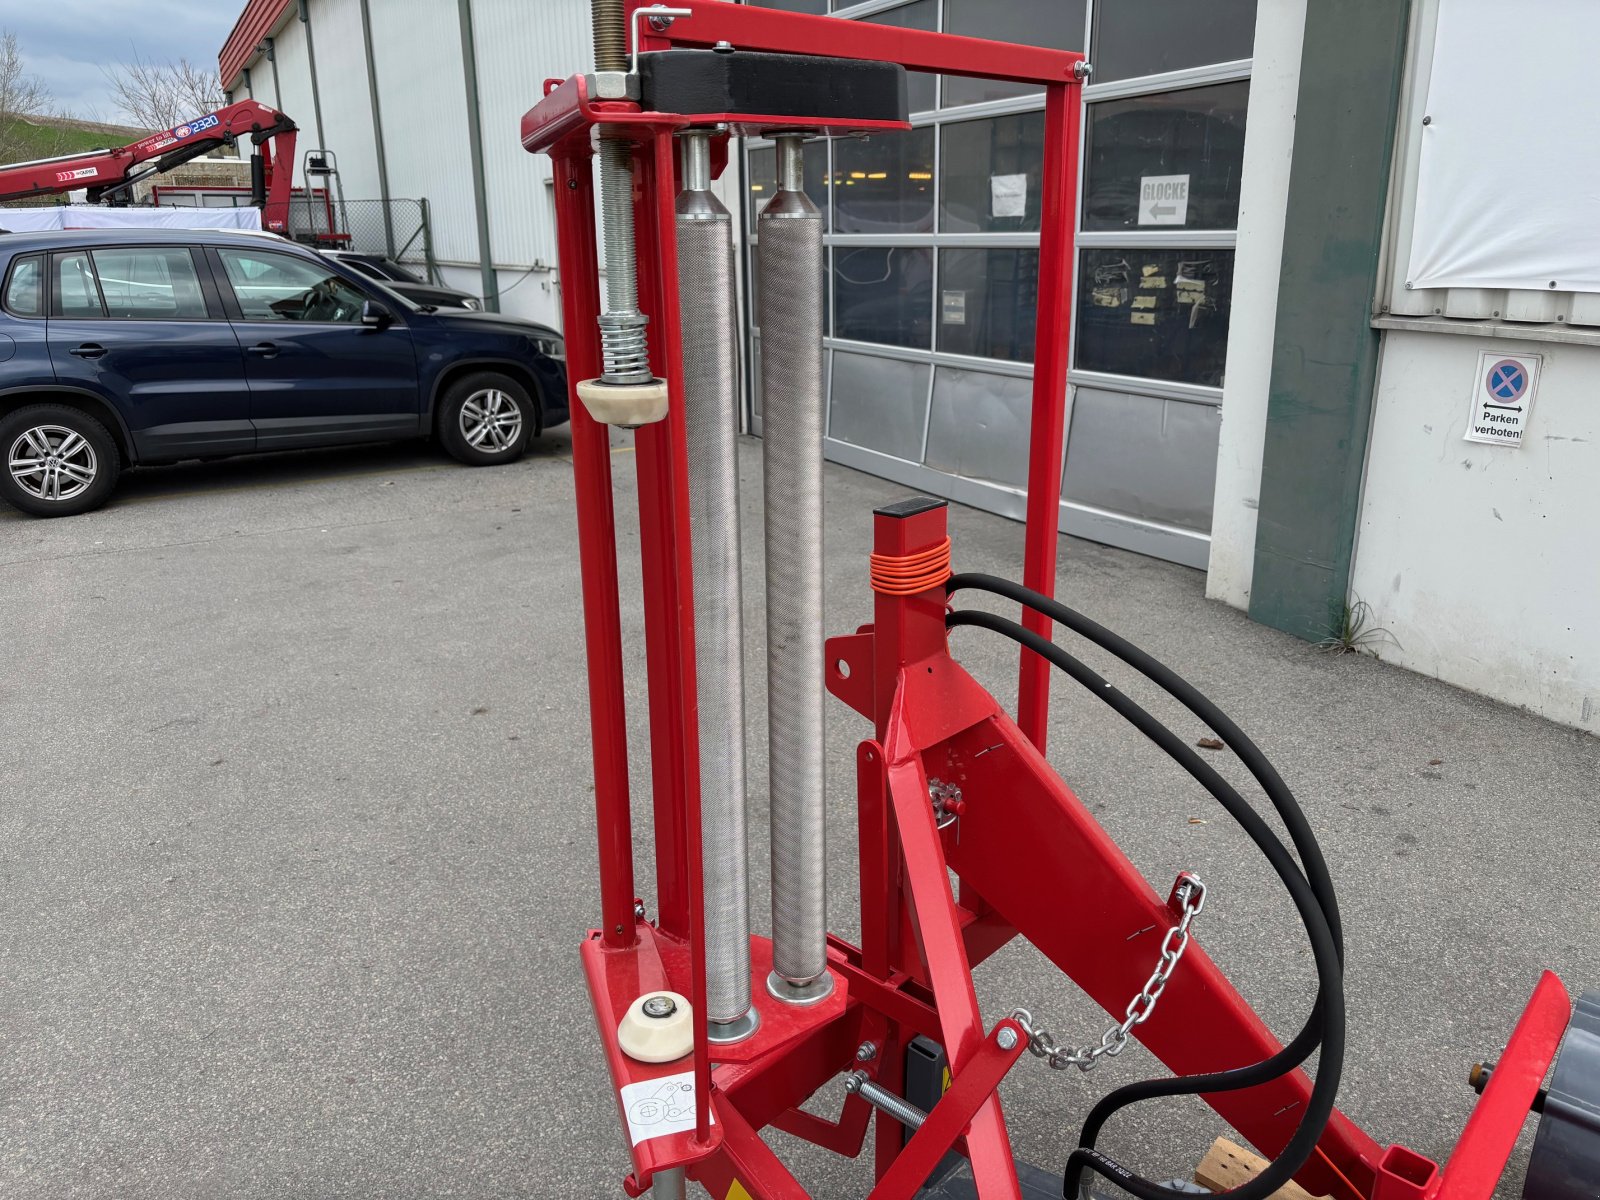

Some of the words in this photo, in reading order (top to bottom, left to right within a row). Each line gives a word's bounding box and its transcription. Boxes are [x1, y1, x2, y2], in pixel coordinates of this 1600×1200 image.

[191, 115, 219, 132] 2320
[137, 139, 155, 149] power
[162, 131, 172, 140] lift
[1142, 182, 1186, 200] GLOCKE
[1483, 411, 1519, 425] Parken
[1475, 425, 1523, 439] verboten!
